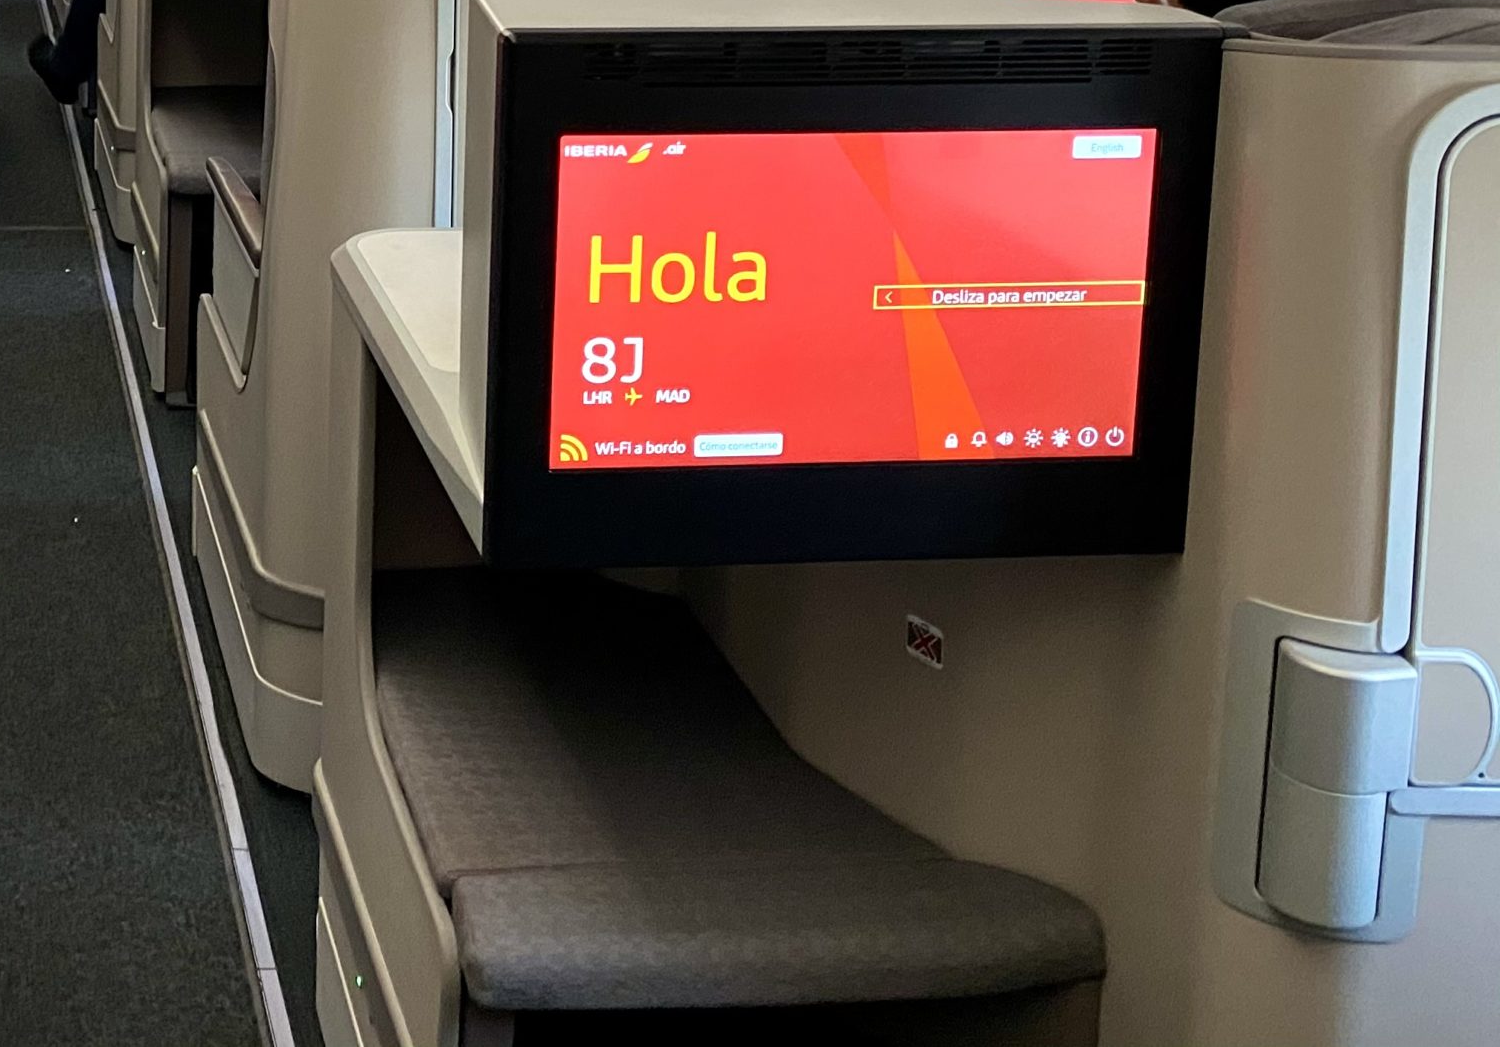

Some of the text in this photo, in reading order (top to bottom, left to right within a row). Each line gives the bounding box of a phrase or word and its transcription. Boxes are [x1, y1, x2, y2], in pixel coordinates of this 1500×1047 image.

[564, 144, 628, 157] IBERIA
[589, 231, 767, 303] Hola
[932, 289, 1088, 305] Desliza para empezar
[581, 336, 644, 384] 8J
[583, 389, 691, 405] LHR MAD
[595, 440, 686, 456] Wi-Fi a bordo
